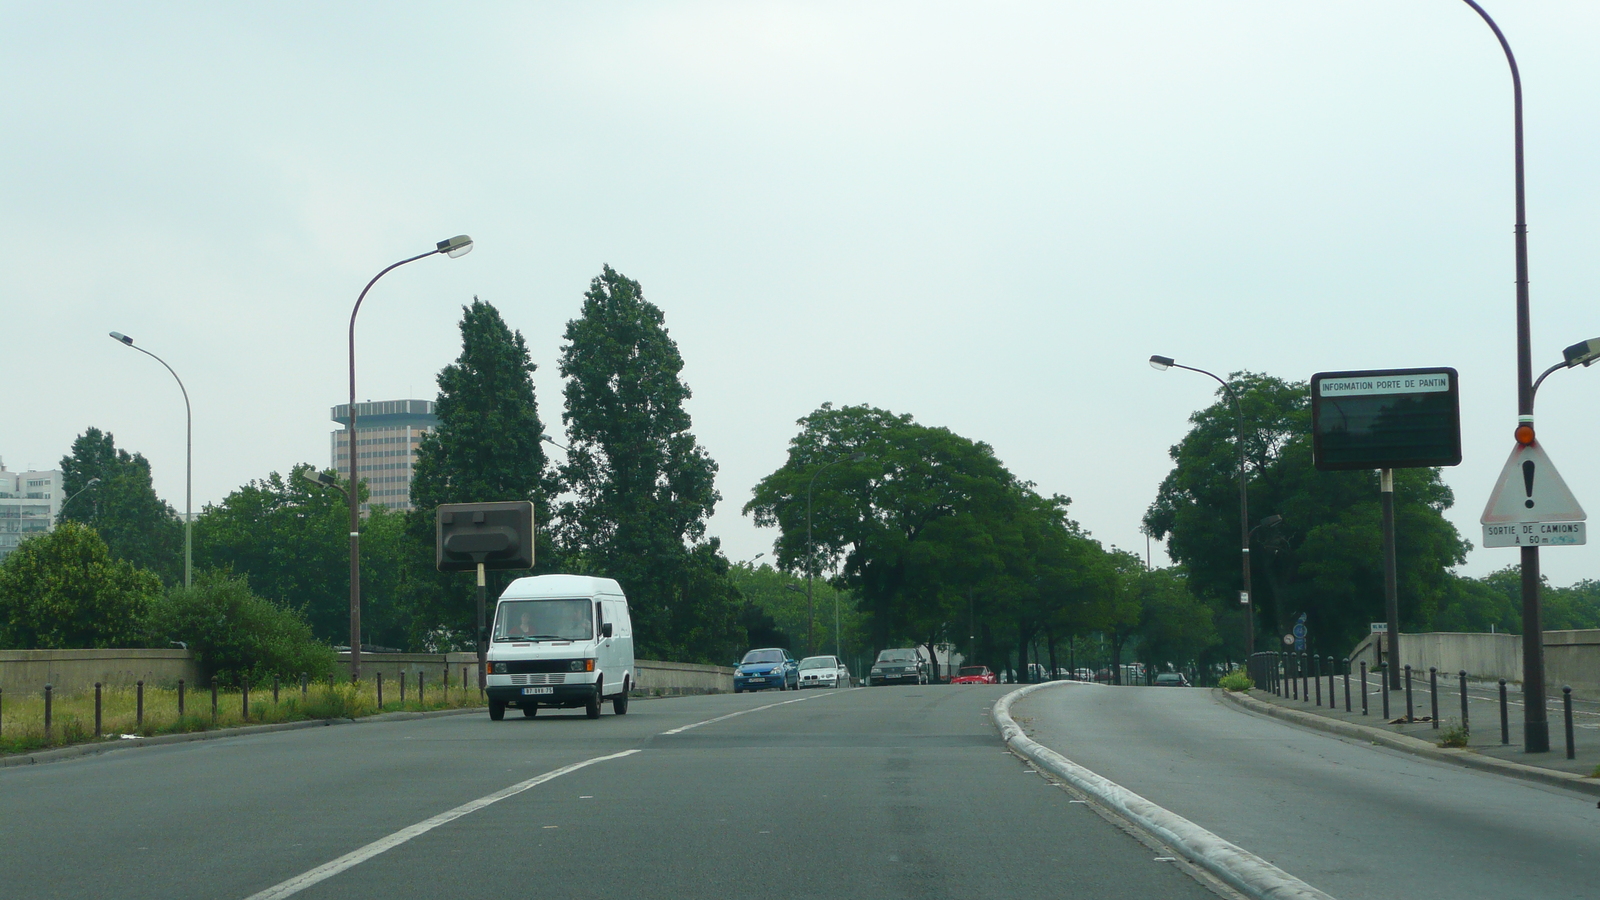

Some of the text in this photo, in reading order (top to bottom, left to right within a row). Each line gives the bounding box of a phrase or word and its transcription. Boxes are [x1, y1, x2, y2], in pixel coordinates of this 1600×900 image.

[1322, 378, 1446, 392] INFORMATION PORTE DE PANTIN
[1488, 524, 1579, 536] SORTIE DE CAMIONS
[1529, 535, 1540, 544] 60
